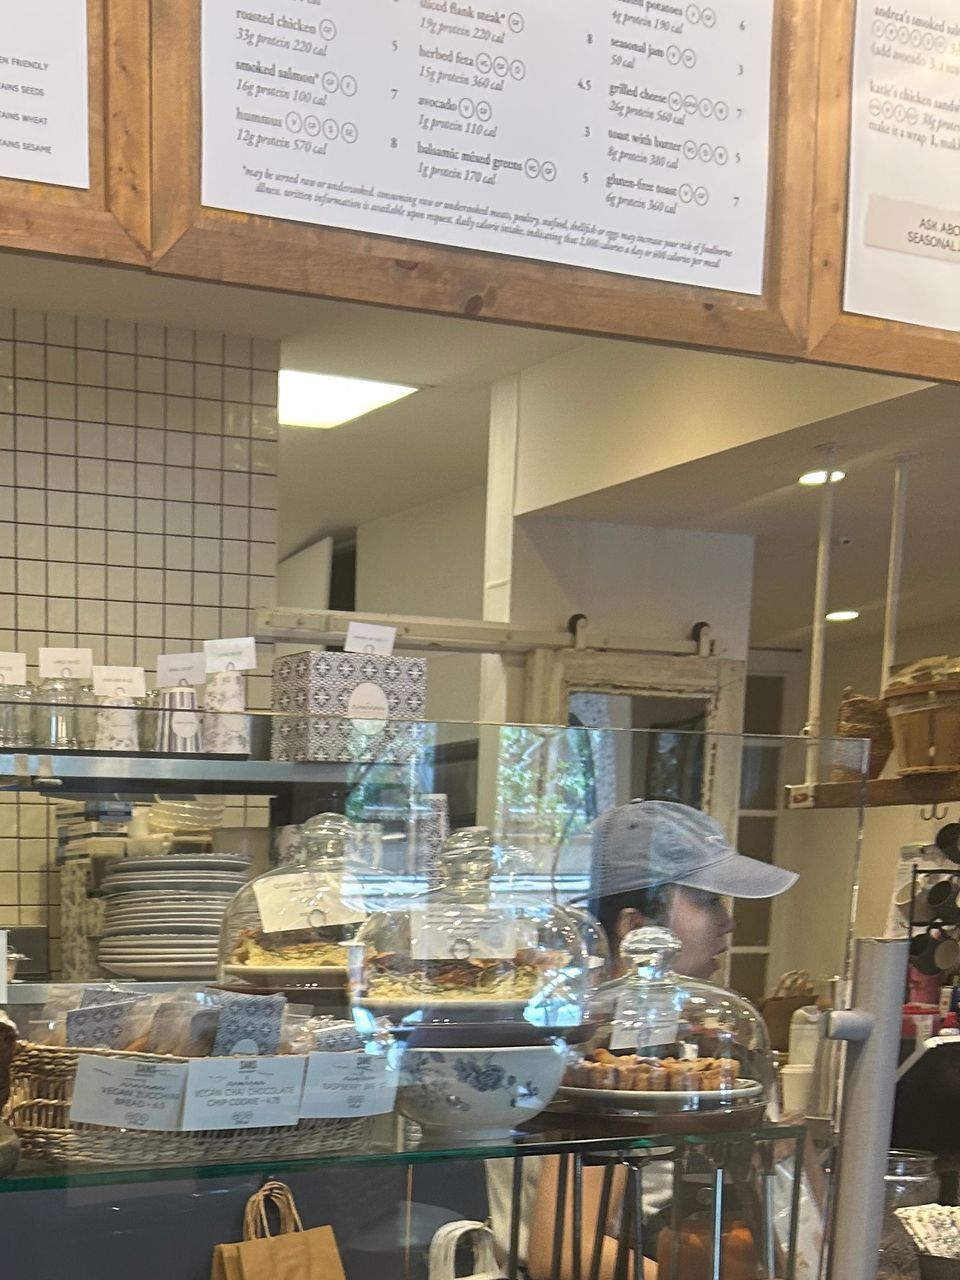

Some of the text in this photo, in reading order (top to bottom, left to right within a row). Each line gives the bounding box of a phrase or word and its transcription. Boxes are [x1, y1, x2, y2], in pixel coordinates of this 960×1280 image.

[236, 9, 317, 34] roasted chicken
[236, 27, 312, 53] 33g 220
[471, 27, 491, 41] 220
[391, 40, 399, 51] 5
[610, 37, 665, 59] seasonal jam
[418, 44, 454, 63] herbed
[11, 57, 48, 71] FRIENDLY
[235, 60, 276, 77] smoked
[471, 75, 491, 89] 360
[20, 85, 45, 97] SEEDS
[236, 78, 312, 104] 16g 100
[391, 88, 399, 100] 7
[608, 83, 638, 98] grilled
[417, 96, 458, 112] avocado
[21, 114, 48, 126] WHEAT
[236, 107, 283, 127] hummus
[464, 122, 483, 135] 110
[236, 128, 312, 153] 12g 570
[22, 143, 53, 155] SESAME
[417, 141, 459, 160] balsamic
[460, 151, 491, 166] mixed
[463, 170, 482, 184] 170
[919, 218, 938, 233] ASK
